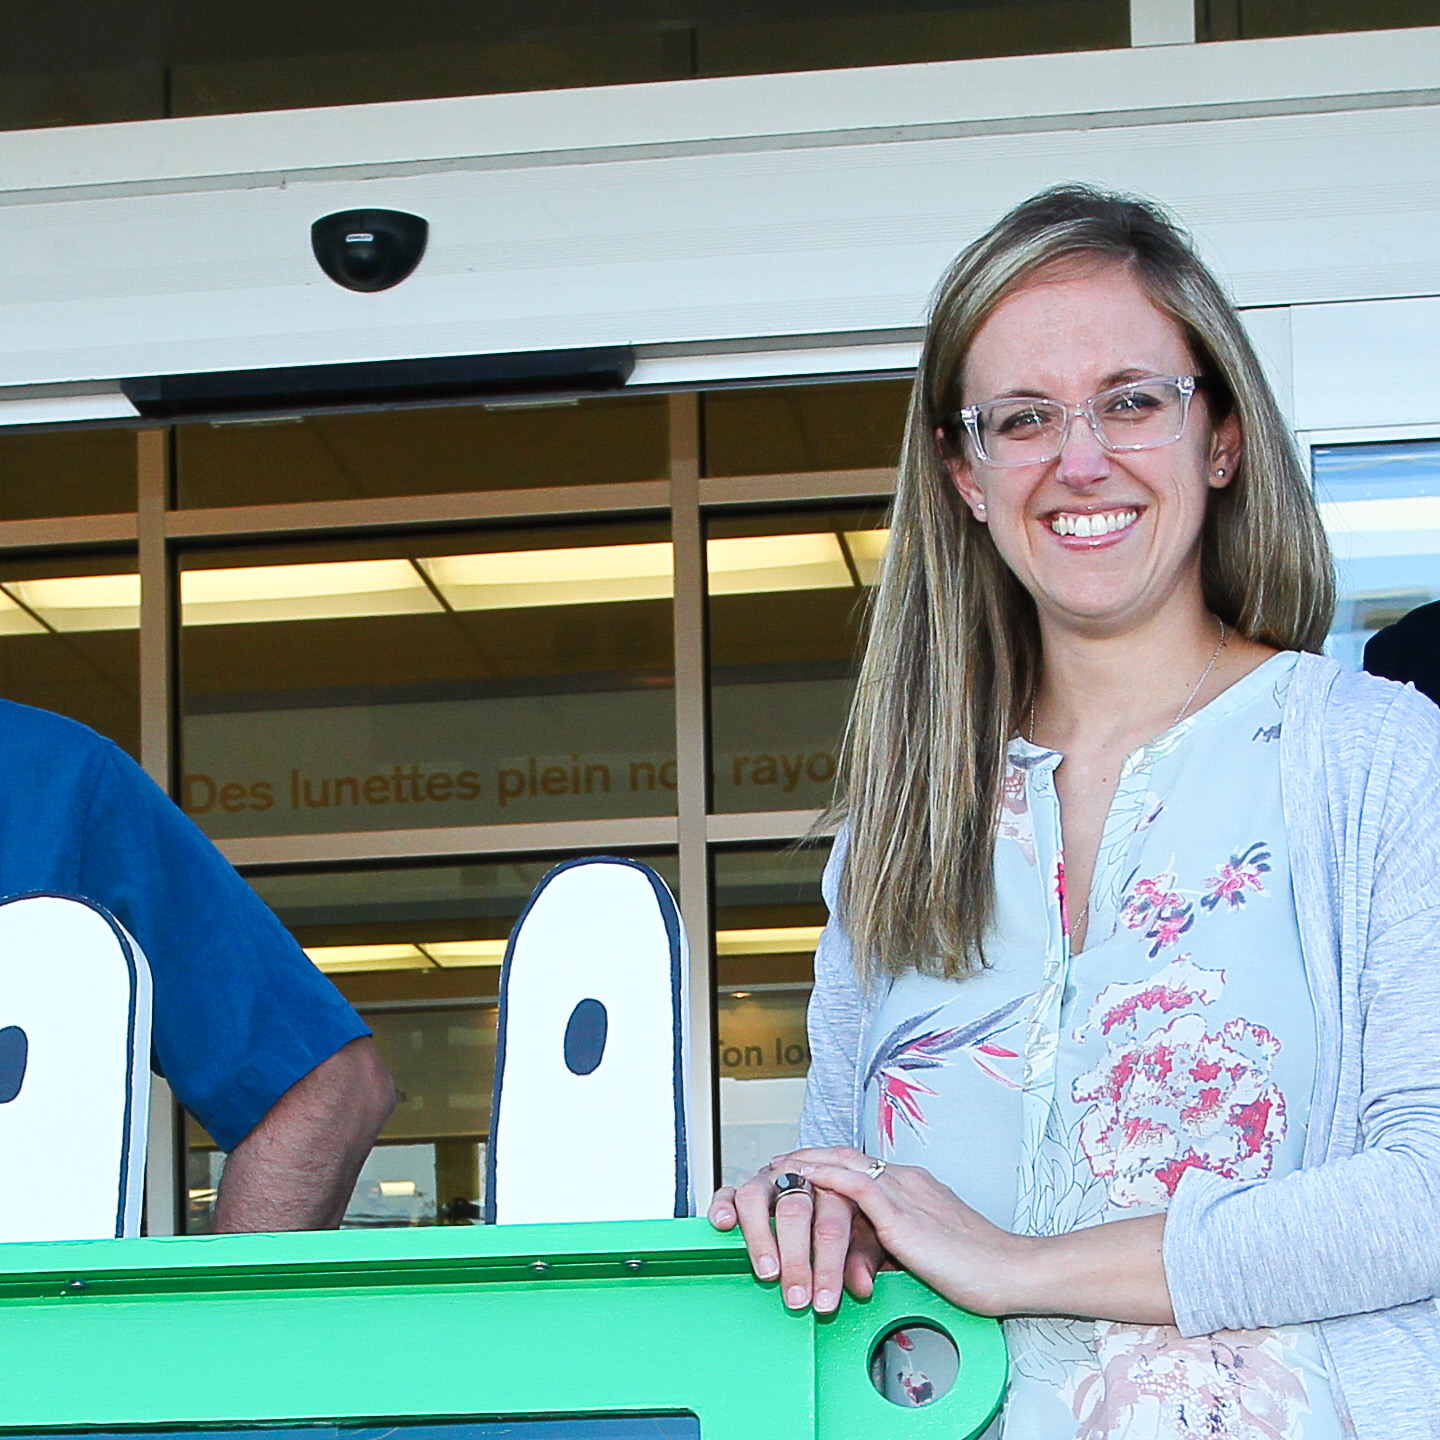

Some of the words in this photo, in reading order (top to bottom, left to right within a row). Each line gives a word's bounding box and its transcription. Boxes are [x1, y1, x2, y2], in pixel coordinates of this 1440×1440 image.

[183, 773, 275, 815] Des
[291, 764, 481, 810] lunettes
[498, 754, 611, 807] plein
[719, 1040, 763, 1067] on
[775, 1037, 811, 1066] lo
